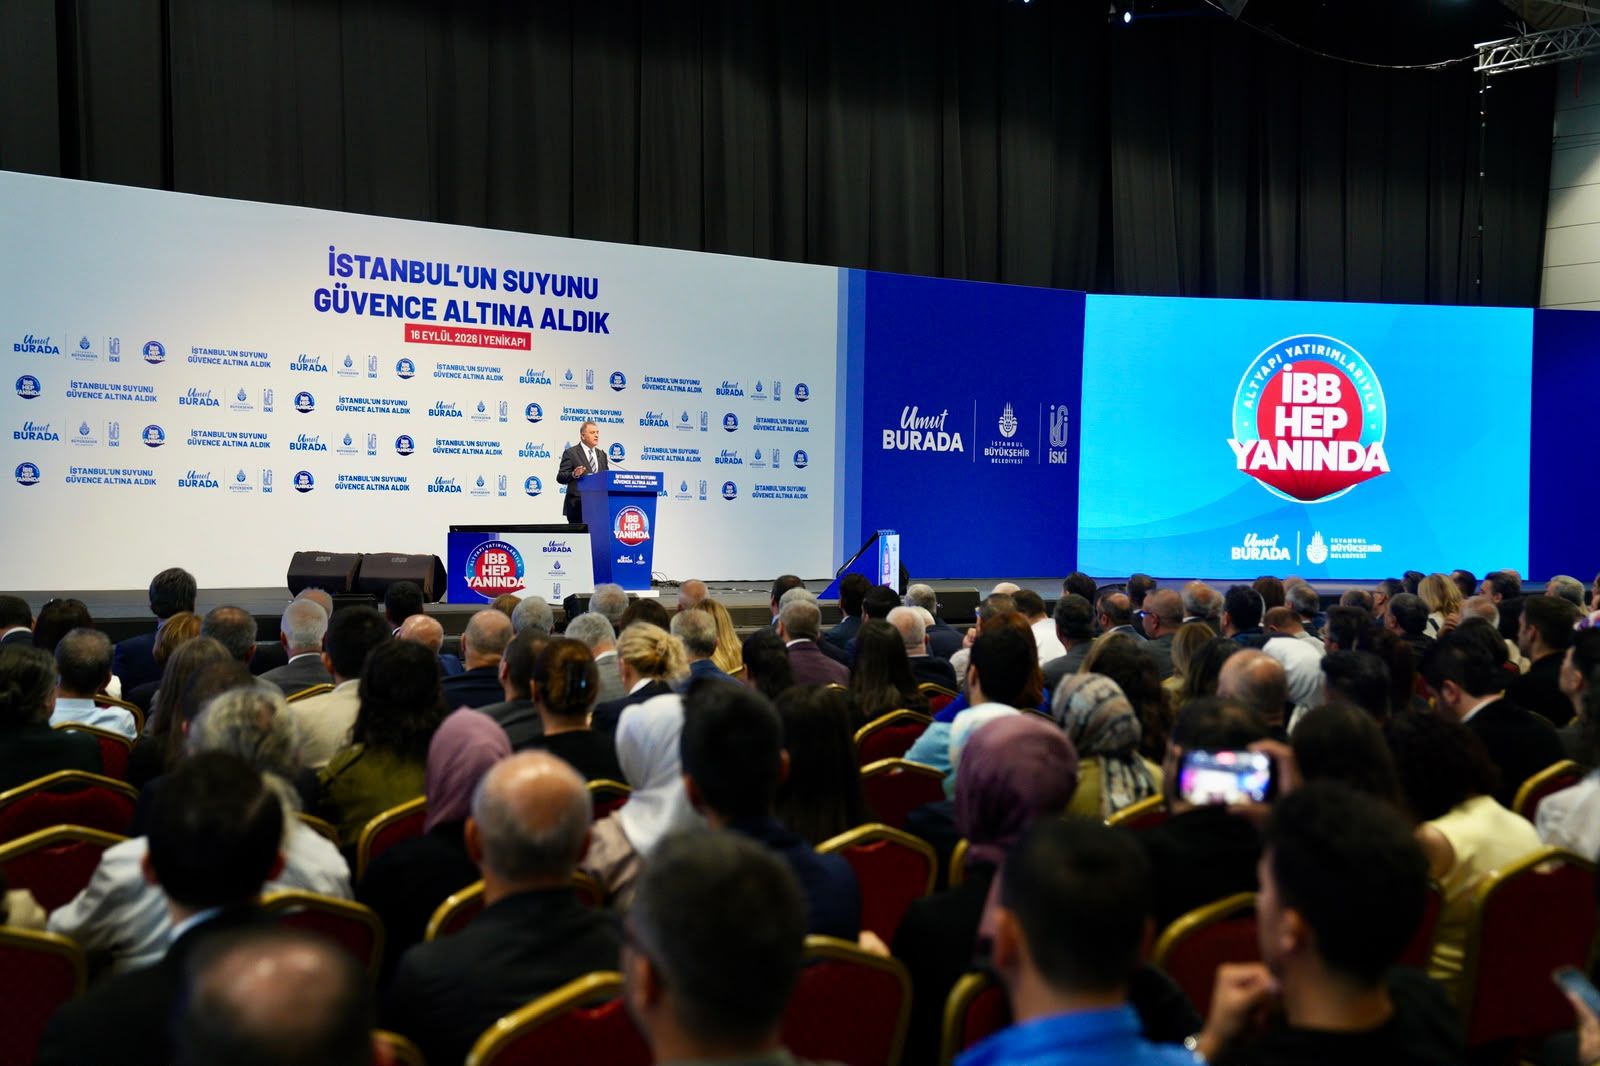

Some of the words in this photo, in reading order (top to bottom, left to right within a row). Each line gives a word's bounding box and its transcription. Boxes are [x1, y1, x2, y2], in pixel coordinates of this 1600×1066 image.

[328, 246, 496, 290] İSTANBUL'UN
[502, 270, 598, 300] SUYUNU
[314, 282, 436, 320] GÜVENCE
[443, 300, 534, 328] ALTINA
[540, 308, 610, 334] ALDIK
[411, 330, 420, 340] 16
[422, 329, 452, 342] EYLÜL
[455, 333, 478, 344] 2026
[484, 334, 526, 346] YENİKAPI
[14, 343, 59, 354] BURADA
[240, 351, 268, 359] SUYUNU
[188, 356, 221, 365] GÜVENCE
[290, 363, 328, 372] BURADA
[434, 370, 461, 378] GÜVENCE
[1243, 354, 1283, 408] ALTYAPI
[1285, 344, 1376, 412] YATIRIMLARIYLA
[520, 376, 551, 384] BURADA
[1282, 363, 1342, 404] İBB
[123, 385, 153, 393] SUYUNU
[716, 388, 744, 396] BURADA
[67, 390, 102, 399] GÜVENCE
[105, 393, 132, 401] ALTINA
[179, 397, 219, 406] BURADA
[336, 404, 365, 412] GÜVENCE
[429, 409, 462, 417] BURADA
[640, 419, 669, 427] BURADA
[901, 406, 948, 431] Umut
[1275, 406, 1348, 437] HEP
[14, 431, 59, 441] BURADA
[188, 438, 221, 446] GÜVENCE
[883, 430, 964, 452] BURADA
[290, 442, 327, 451] BURADA
[433, 446, 460, 454] GÜVENCE
[519, 450, 550, 458] BURADA
[985, 448, 1029, 457] BÜYÜKŞEHİR
[1049, 448, 1067, 464] İSKİ
[1227, 439, 1391, 472] YANINDA
[715, 457, 742, 465] BURADA
[66, 475, 102, 484] GÜVENCE
[178, 479, 219, 488] BURADA
[335, 482, 365, 490] GÜVENCE
[428, 484, 461, 492] BURADA
[626, 513, 639, 522] İBB
[614, 531, 650, 539] YANINDA
[1244, 533, 1279, 548] Umut
[485, 550, 507, 564] İBB
[1231, 546, 1290, 560] BURADA
[482, 565, 510, 575] HEP
[464, 576, 526, 587] YANINDA
